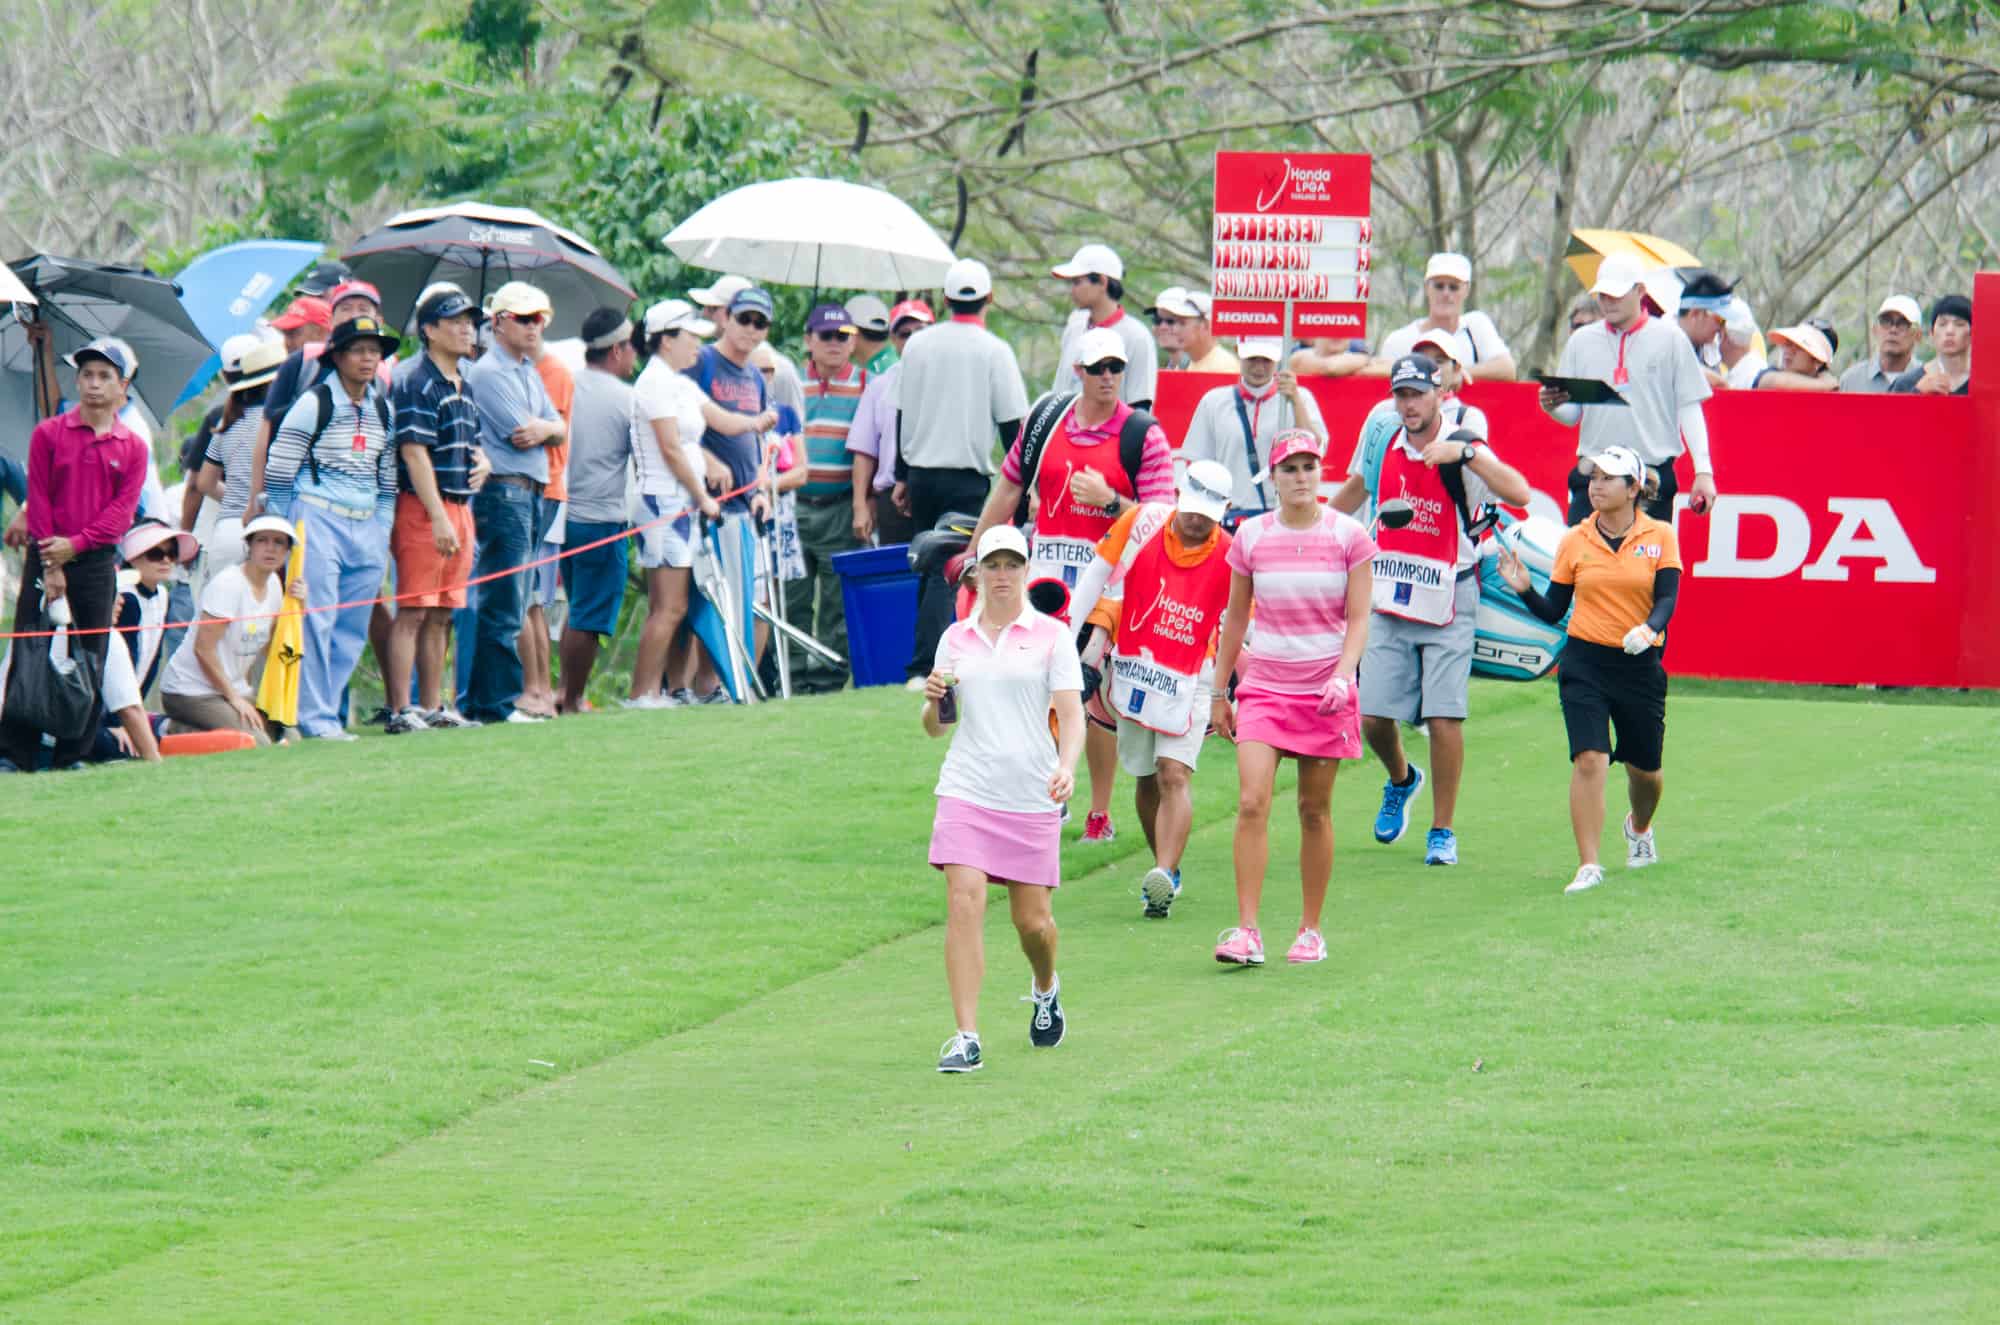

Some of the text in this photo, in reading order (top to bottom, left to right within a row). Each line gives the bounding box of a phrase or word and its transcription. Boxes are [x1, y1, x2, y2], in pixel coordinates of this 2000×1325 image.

[1290, 168, 1331, 182] Honda
[1296, 181, 1325, 192] LPGA
[1217, 217, 1323, 241] PETTERSEN
[1216, 245, 1311, 269] THOMPSON
[1216, 273, 1328, 298] SUWANNAPURA
[1217, 311, 1278, 323] HONDA
[1299, 313, 1360, 325] HONDA
[1403, 491, 1442, 513] Honda
[1414, 509, 1436, 524] PGA
[1037, 542, 1095, 564] PETTERS
[1372, 559, 1441, 586] THOMPSON
[1158, 595, 1204, 623] Honda
[1153, 623, 1196, 647] THAILAND
[1160, 615, 1193, 634] LPGA
[1475, 640, 1541, 665] bra
